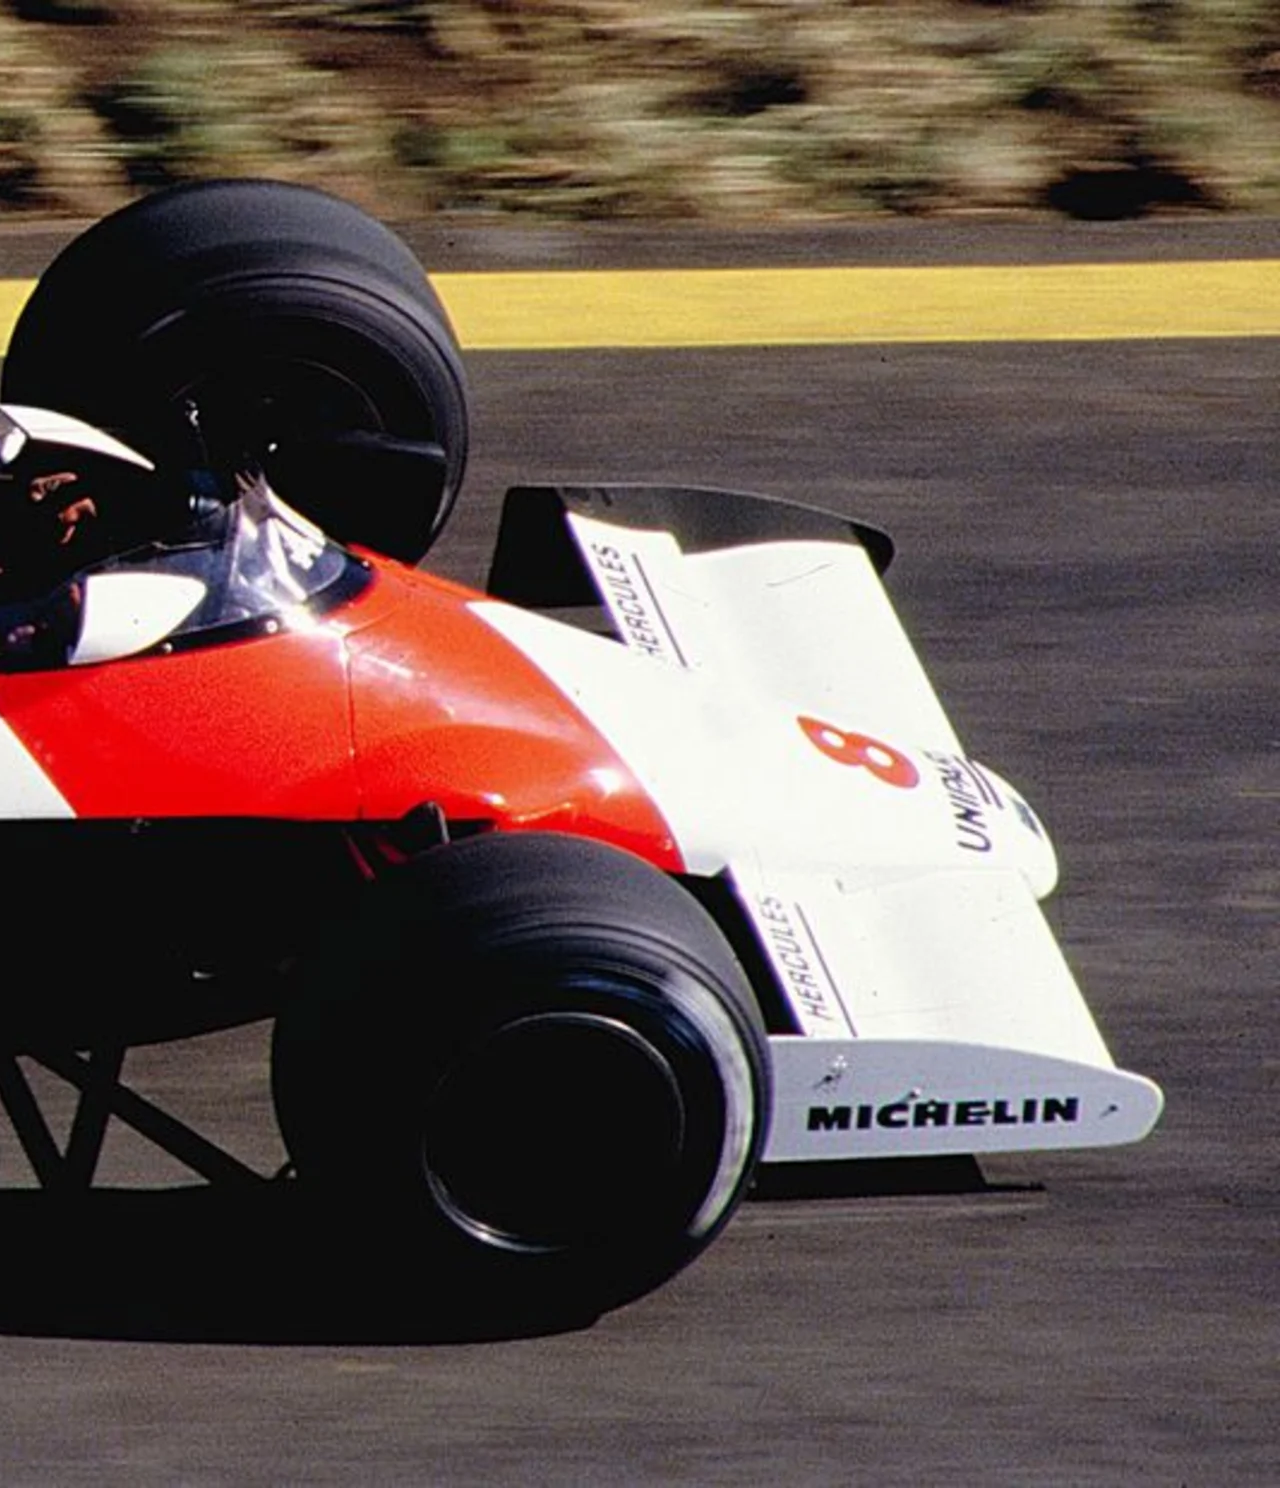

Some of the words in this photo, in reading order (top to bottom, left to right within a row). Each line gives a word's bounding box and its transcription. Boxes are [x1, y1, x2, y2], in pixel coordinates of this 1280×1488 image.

[796, 716, 920, 789] 8
[758, 893, 834, 1022] HERCULES
[806, 1097, 1079, 1132] MICHELIN
